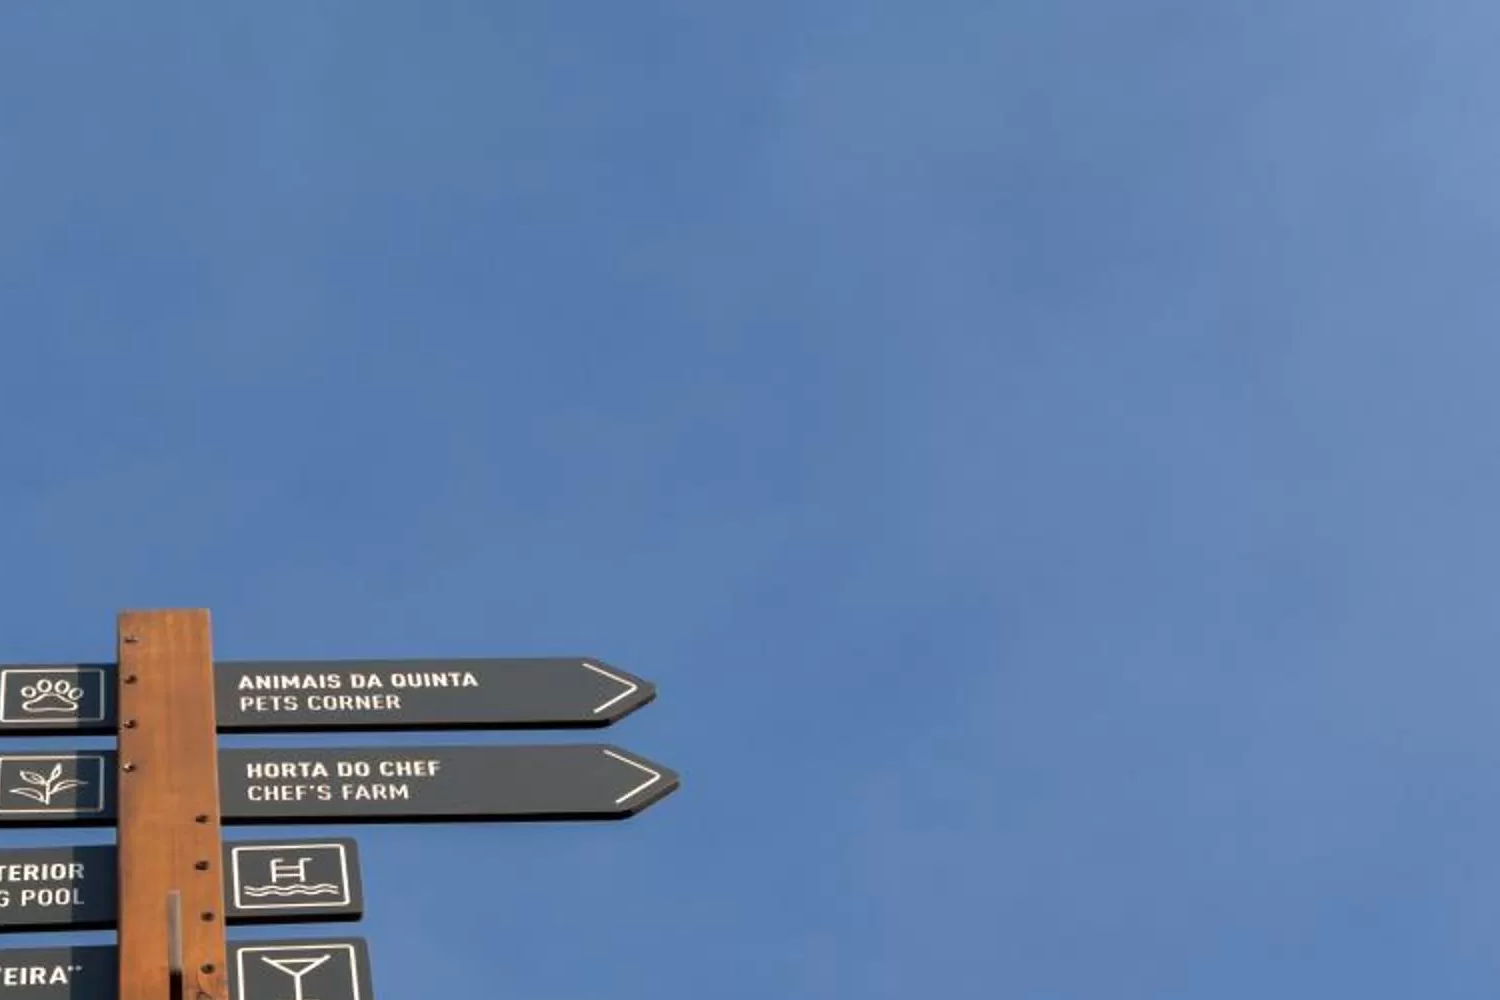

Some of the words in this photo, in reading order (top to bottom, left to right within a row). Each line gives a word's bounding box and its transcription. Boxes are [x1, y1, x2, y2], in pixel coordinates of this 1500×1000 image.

[237, 673, 342, 691] ANIMAIS
[349, 673, 384, 690] DA
[390, 671, 479, 689] QUINTA
[239, 695, 299, 713] PETS
[307, 693, 402, 711] CORNER
[246, 761, 330, 779] HORTA
[336, 761, 371, 778] DO
[379, 760, 441, 777] CHEF
[341, 783, 410, 801] FARM
[20, 887, 85, 907] POOL
